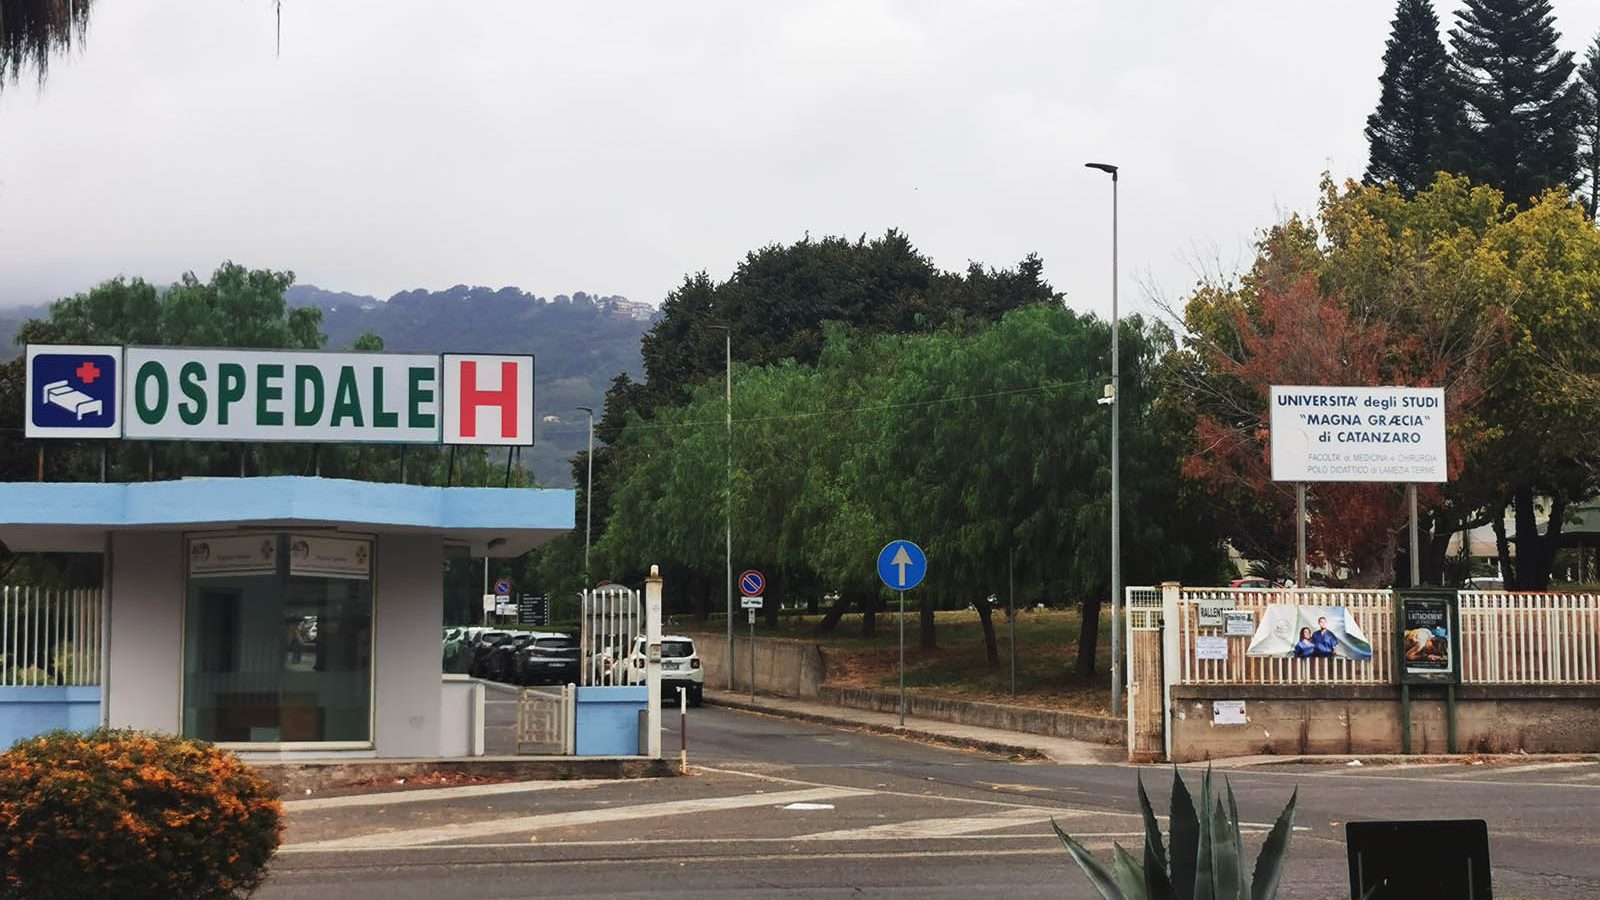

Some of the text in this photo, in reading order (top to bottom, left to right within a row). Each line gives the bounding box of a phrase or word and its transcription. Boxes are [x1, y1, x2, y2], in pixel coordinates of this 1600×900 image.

[134, 360, 436, 428] OSPEDALE
[459, 360, 519, 438] H
[1277, 394, 1439, 411] UNIVERSITA' degli STUDI
[1299, 414, 1362, 426] "MAGNA
[1318, 431, 1421, 444] di CATANZARO
[1353, 453, 1388, 462] MEDICINA
[1398, 453, 1438, 463] CHIRURGIA
[1307, 465, 1328, 474] POLO
[1330, 465, 1369, 474] DIDATTICO
[1379, 465, 1409, 475] LAMEZIA
[1411, 465, 1436, 475] TERME
[1200, 607, 1234, 618] RALLEN
